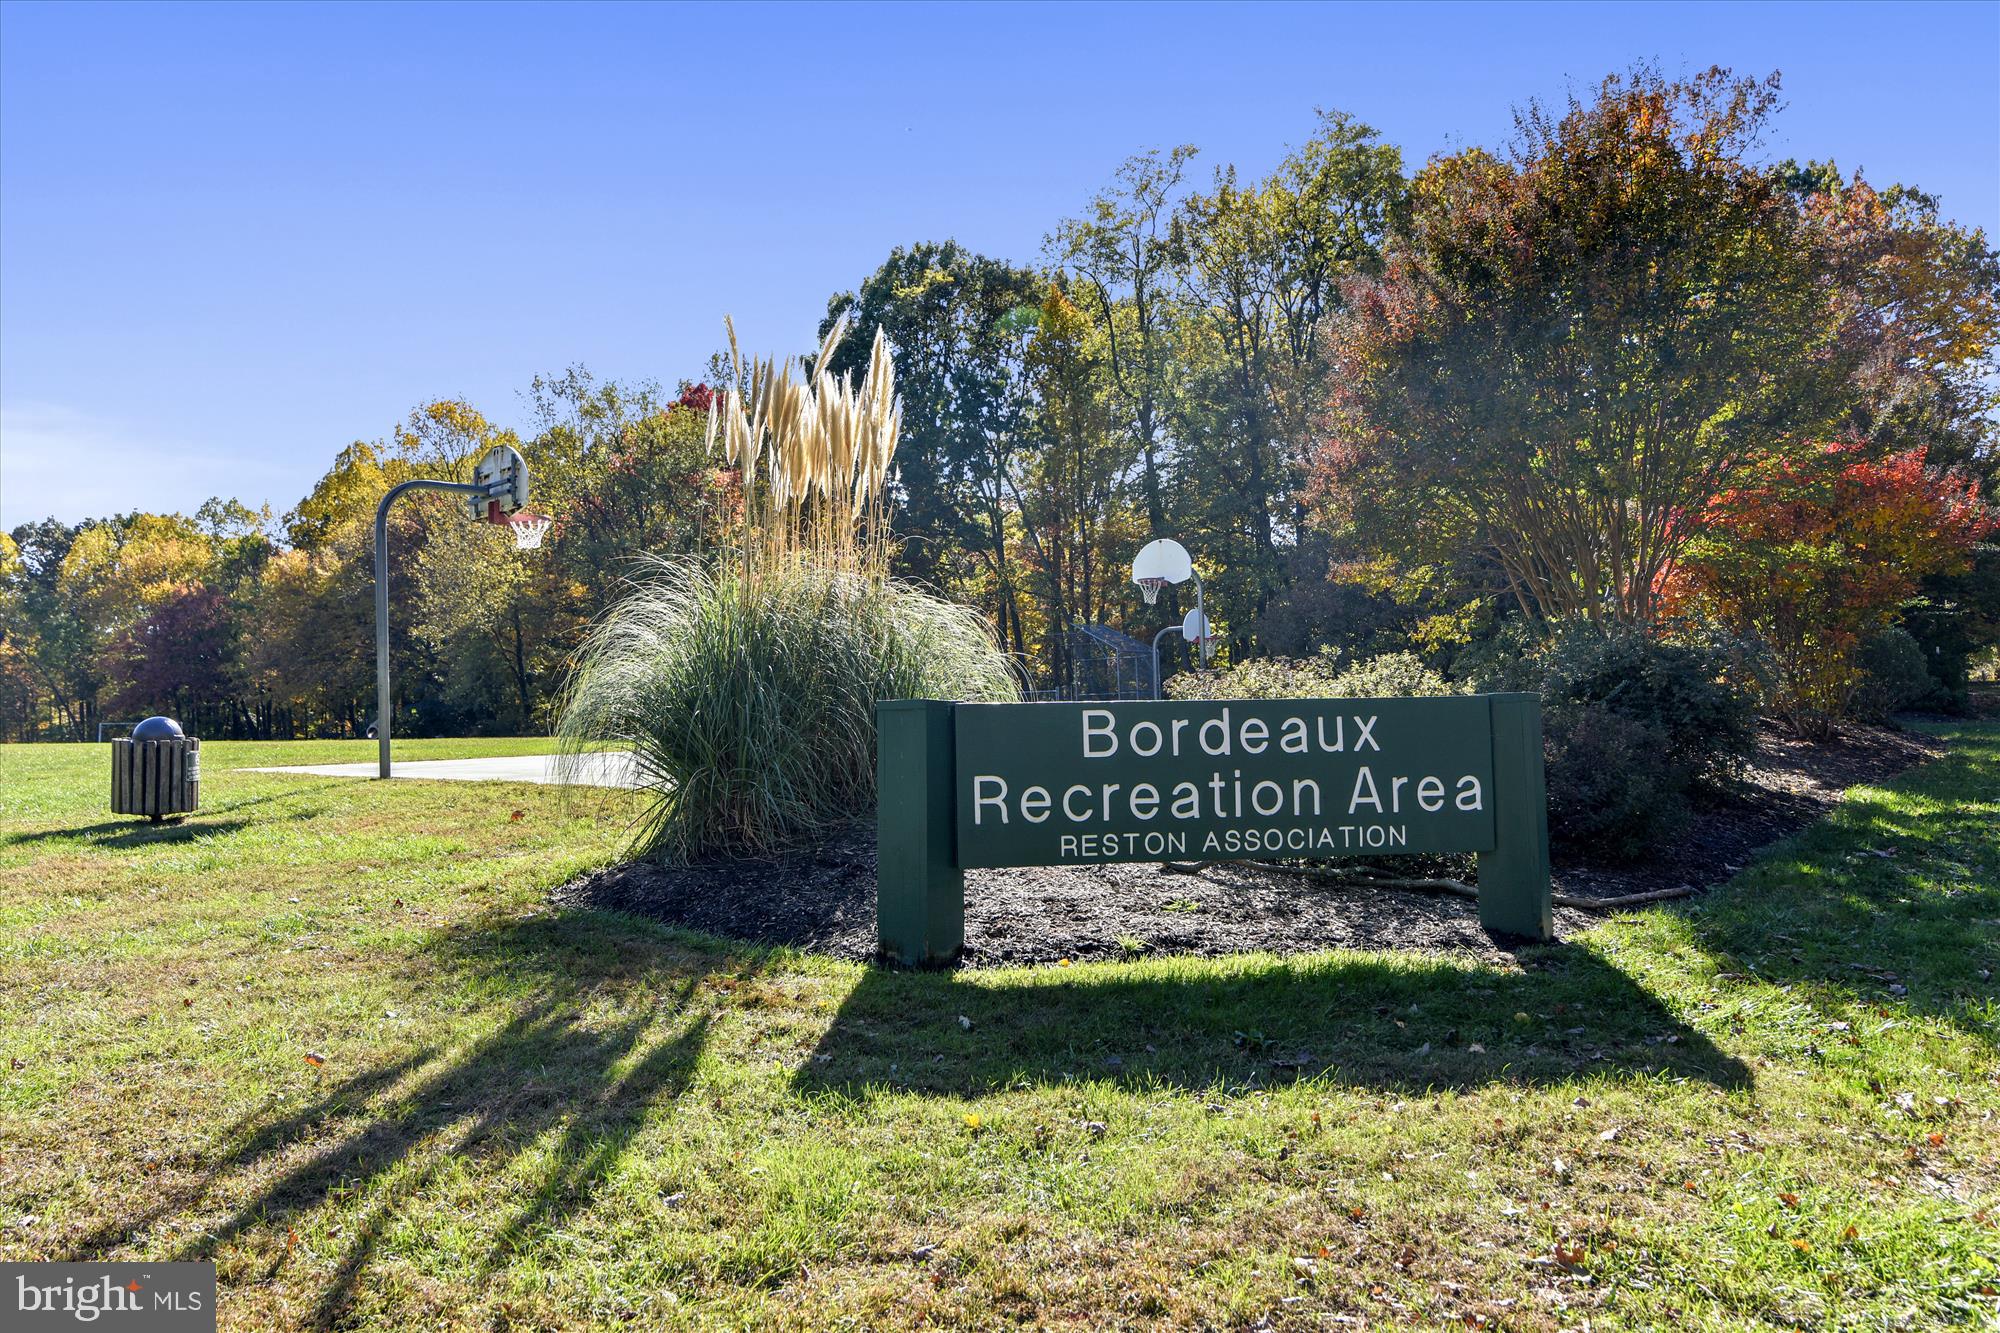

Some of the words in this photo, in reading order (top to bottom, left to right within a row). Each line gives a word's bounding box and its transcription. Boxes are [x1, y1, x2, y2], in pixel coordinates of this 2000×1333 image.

[1082, 707, 1380, 758] Bordeaux
[974, 769, 1320, 825] Recreation
[1348, 766, 1482, 814] Area
[1060, 832, 1186, 857] RESTON
[1202, 825, 1407, 852] ASSOCIATION
